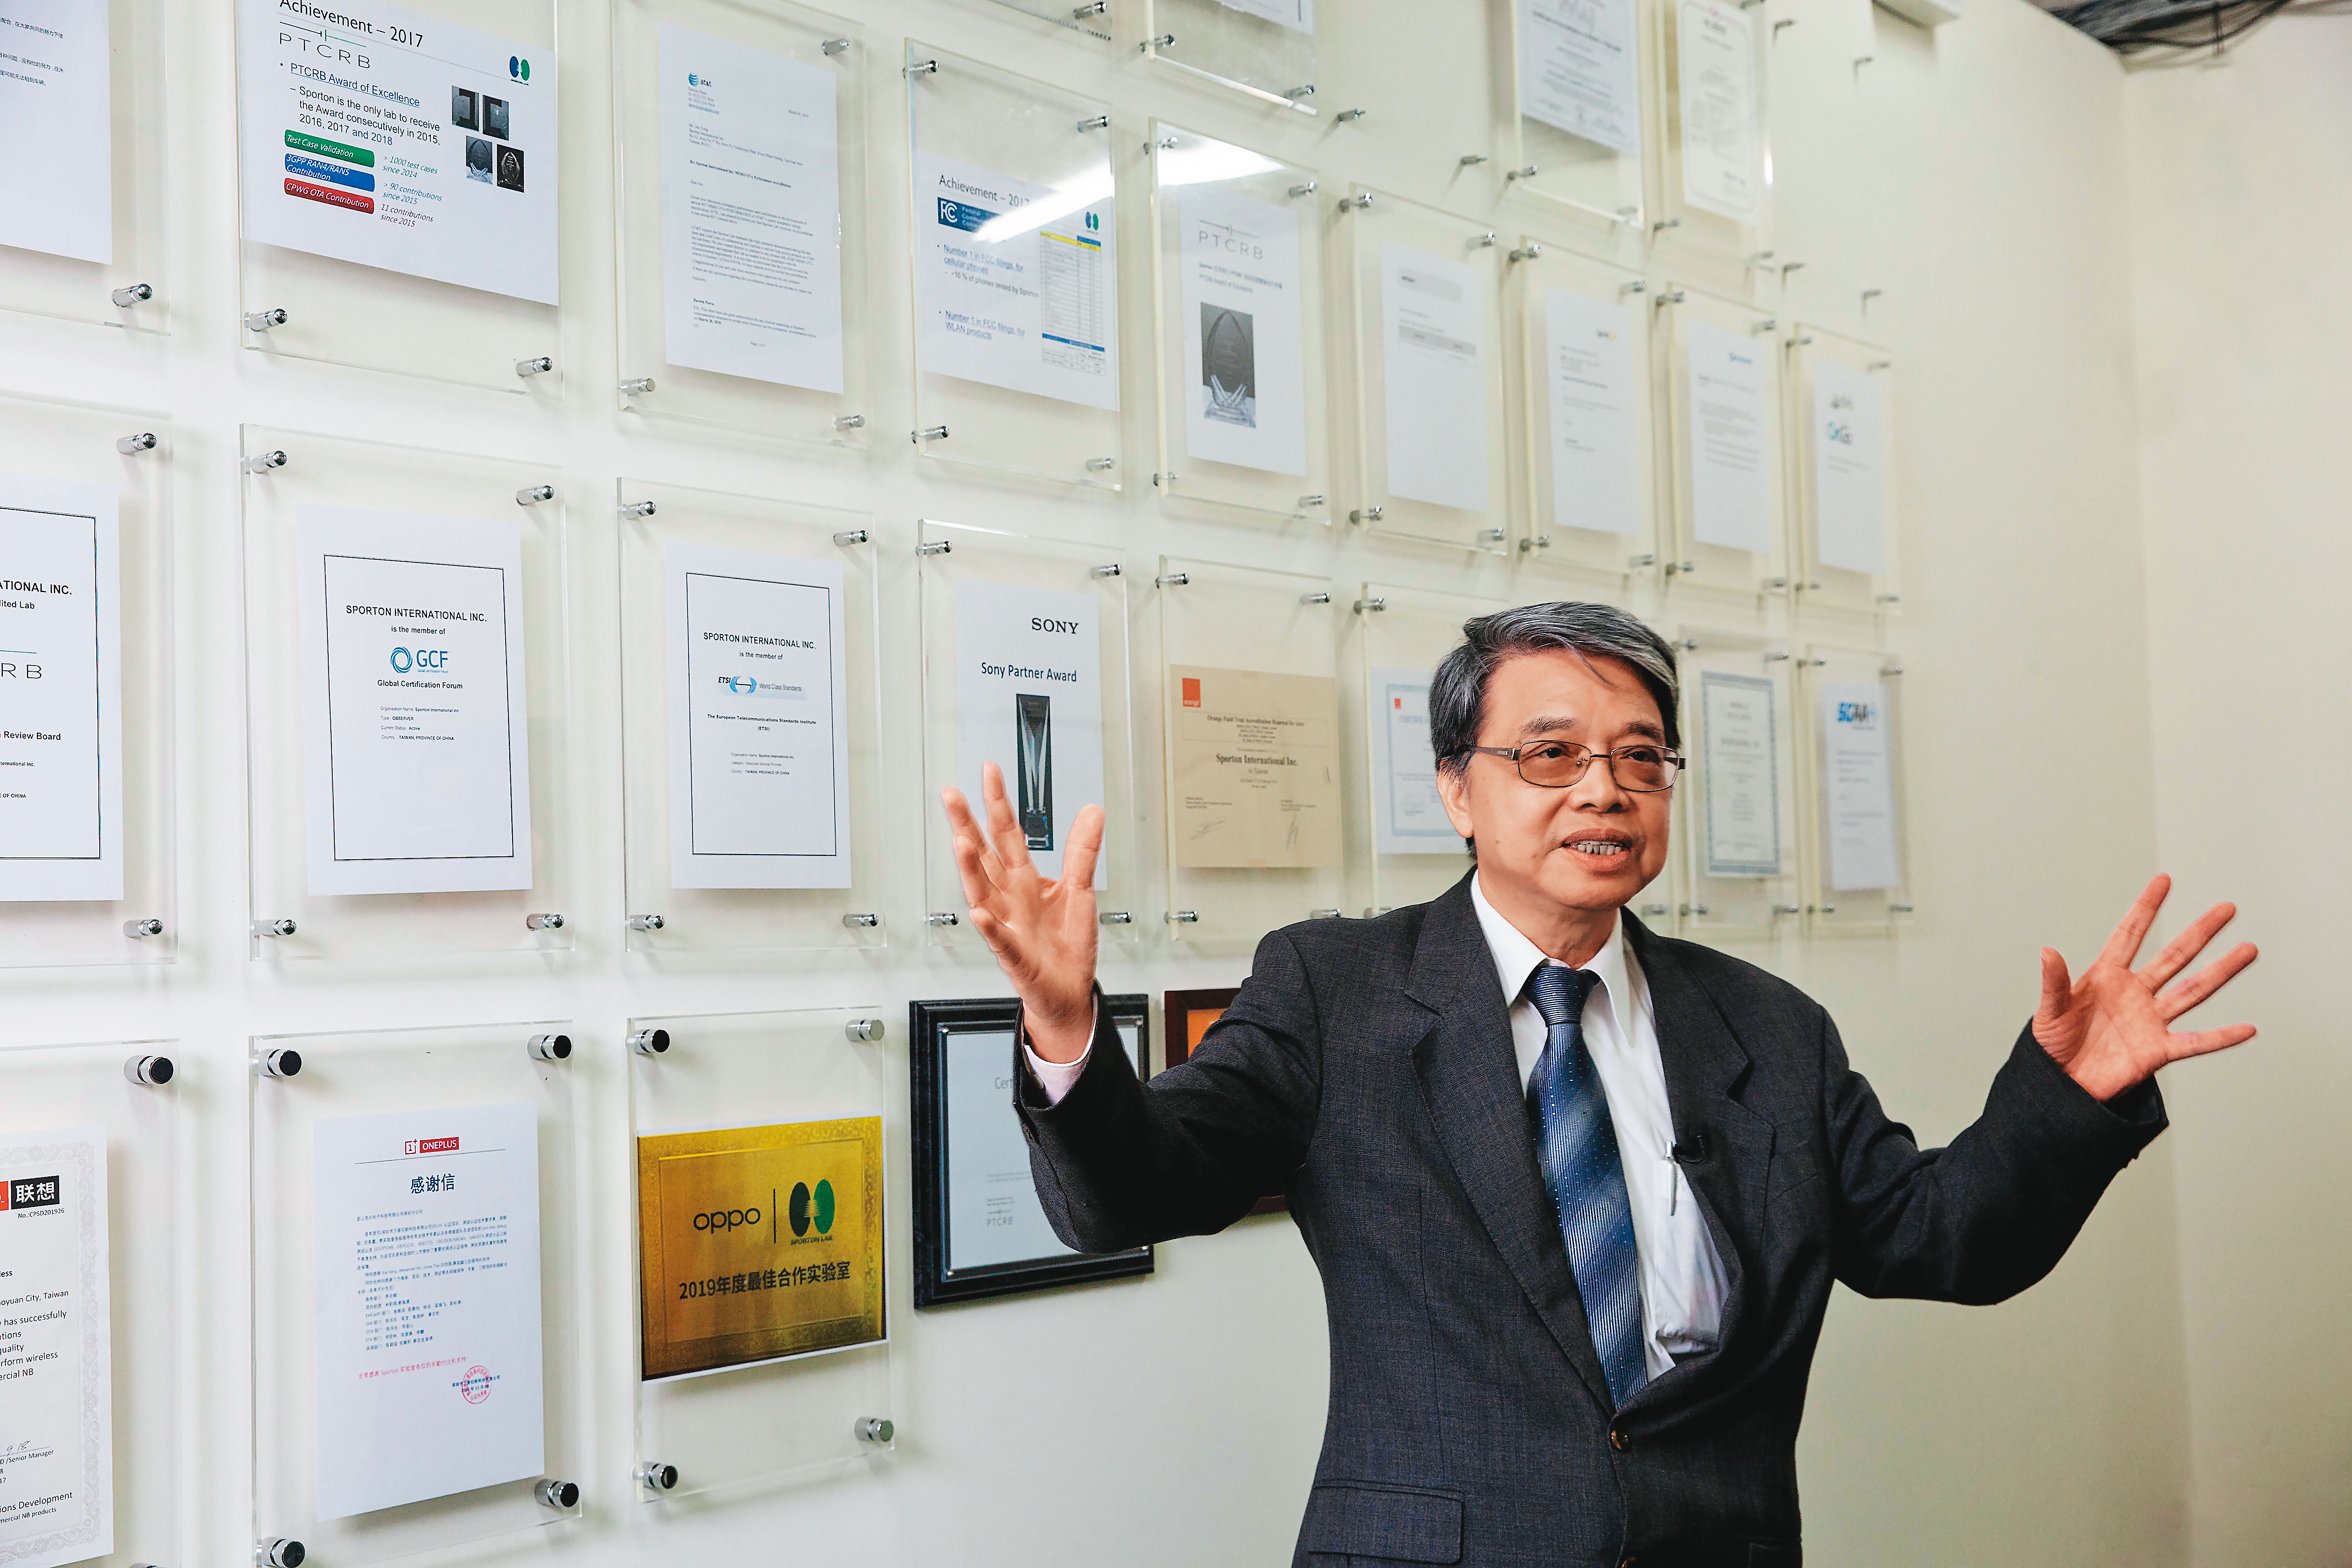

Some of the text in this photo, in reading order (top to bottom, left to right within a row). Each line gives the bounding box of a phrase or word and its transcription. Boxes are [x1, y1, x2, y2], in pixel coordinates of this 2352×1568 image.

[280, 0, 423, 47] Achievement 2017
[280, 33, 370, 69] PTCRB
[291, 63, 420, 106] PTCRB Award of Excellence
[300, 86, 440, 131] Sporton is the only lab to receive
[300, 100, 440, 145] the Award consecutively in 2015,
[300, 114, 392, 145] 2016, 2017 and 2018
[287, 135, 354, 158] Test Case Validation
[286, 154, 350, 176] 3GPP RAN4/RAN5
[287, 164, 331, 181] Contribution
[383, 165, 417, 179] since 2014
[390, 156, 438, 174] 1000 test cases
[286, 183, 370, 209] CPWG OTA Contribution
[399, 185, 442, 201] contributions
[939, 175, 998, 201] Achievement
[383, 191, 417, 205] since 2015
[381, 214, 415, 227] since 2015
[390, 206, 434, 222] contributions
[1198, 230, 1263, 260] PTCRB
[944, 244, 967, 258] Number
[981, 254, 995, 265] FCC
[967, 263, 989, 274] phones
[975, 277, 994, 287] phones
[1019, 287, 1039, 298] Sporton
[945, 310, 969, 323] Number
[983, 318, 996, 330] FCC
[945, 321, 992, 340] WLAN products
[50, 584, 72, 595] INC.
[0, 599, 35, 609] ited Lab
[346, 606, 487, 622] SPORTON INTERNATIONAL INC.
[1031, 617, 1079, 634] SONY
[704, 632, 816, 649] SPORTON INTERNATIONAL INC.
[416, 650, 448, 668] GCF
[981, 662, 1077, 682] Sony Partner Award
[401, 680, 441, 688] Certification
[4, 731, 61, 740] Review Board
[1216, 753, 1242, 764] Sporton
[1244, 755, 1285, 765] International
[422, 1139, 457, 1150] ONEPLUS
[410, 1173, 455, 1194] 感谢信
[16, 1182, 55, 1203] 联想
[693, 1207, 761, 1234] oppo
[679, 1261, 850, 1299] 2019年度最佳合作实验室
[0, 1297, 23, 1306] oyuan
[43, 1290, 69, 1299] Taiwan
[20, 1310, 67, 1324] successfully
[0, 1331, 21, 1340] tions
[26, 1352, 58, 1363] wireless
[22, 1368, 33, 1377] NB
[29, 1450, 54, 1459] Manager
[19, 1491, 73, 1510] Development
[31, 1508, 57, 1518] products
